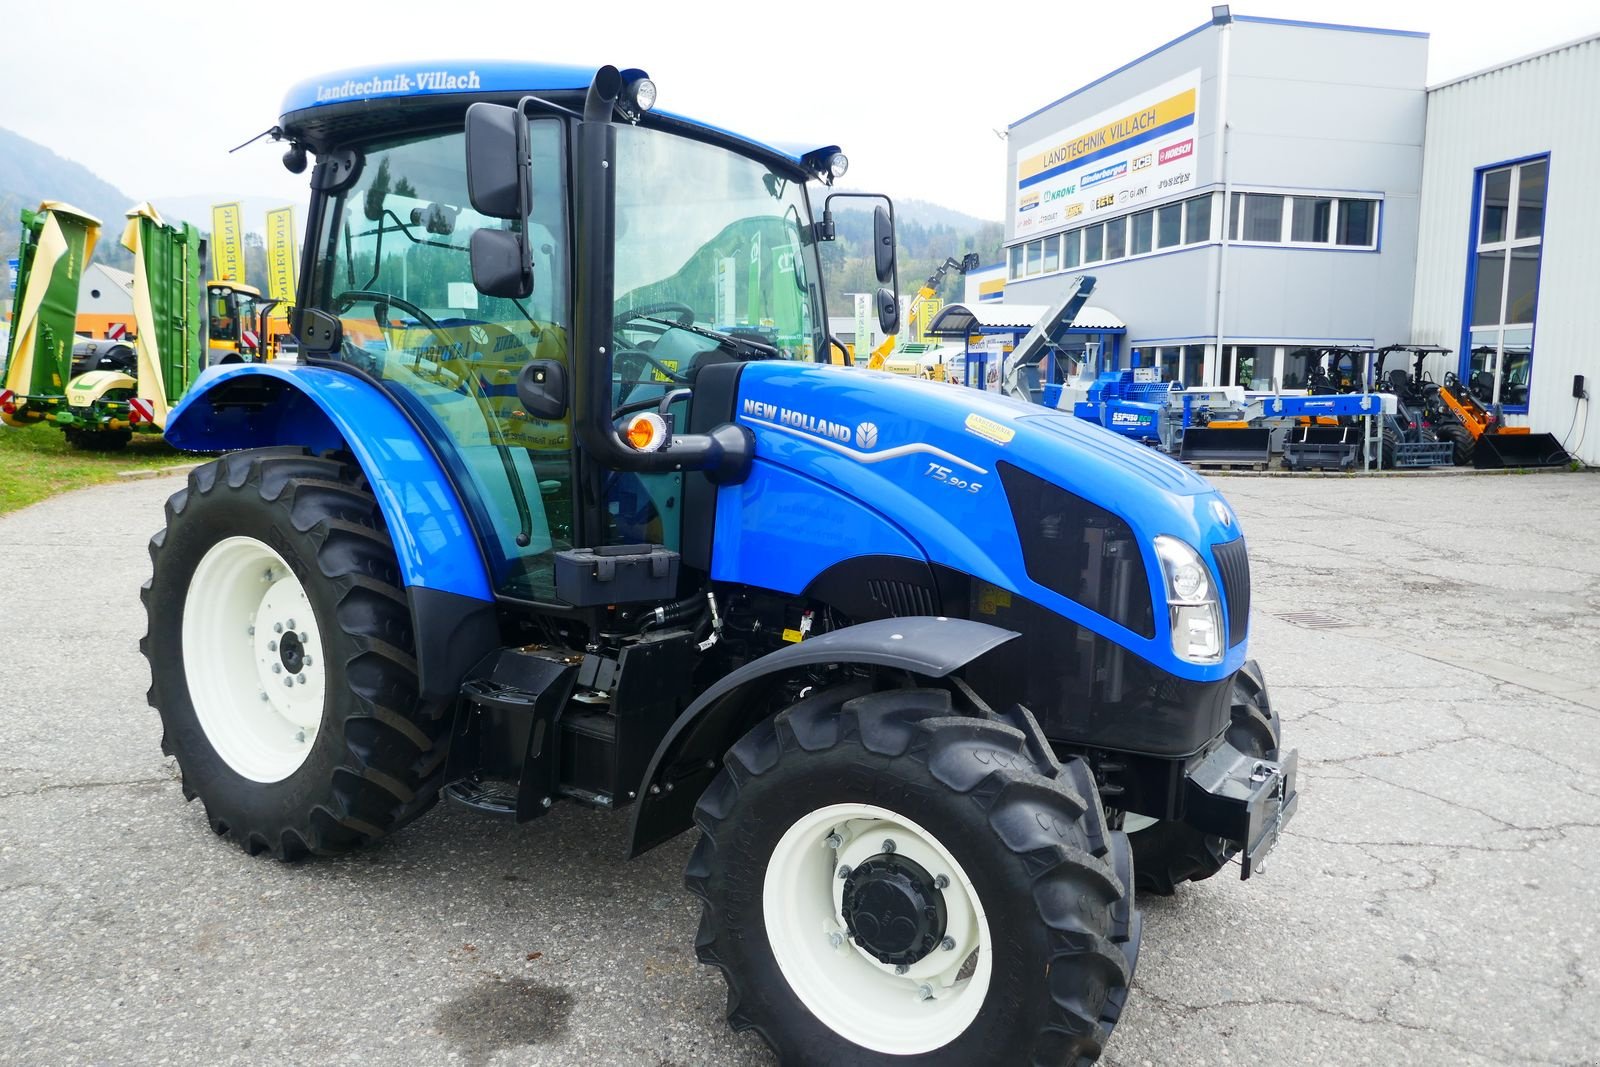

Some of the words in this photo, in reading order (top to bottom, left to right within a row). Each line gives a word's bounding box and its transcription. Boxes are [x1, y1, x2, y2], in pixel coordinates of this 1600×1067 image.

[316, 71, 481, 101] Landtechnik-Villach
[1043, 131, 1106, 168] LANDTECHNIK
[1110, 109, 1157, 138] VILLACH
[1133, 155, 1153, 170] JCB
[1165, 143, 1192, 160] HORSCH
[1051, 185, 1076, 200] KRONE
[1130, 186, 1148, 198] GIANT
[743, 398, 778, 420] NEW
[780, 407, 851, 443] HOLLAND
[923, 462, 968, 490] T5.90
[969, 482, 983, 494] S
